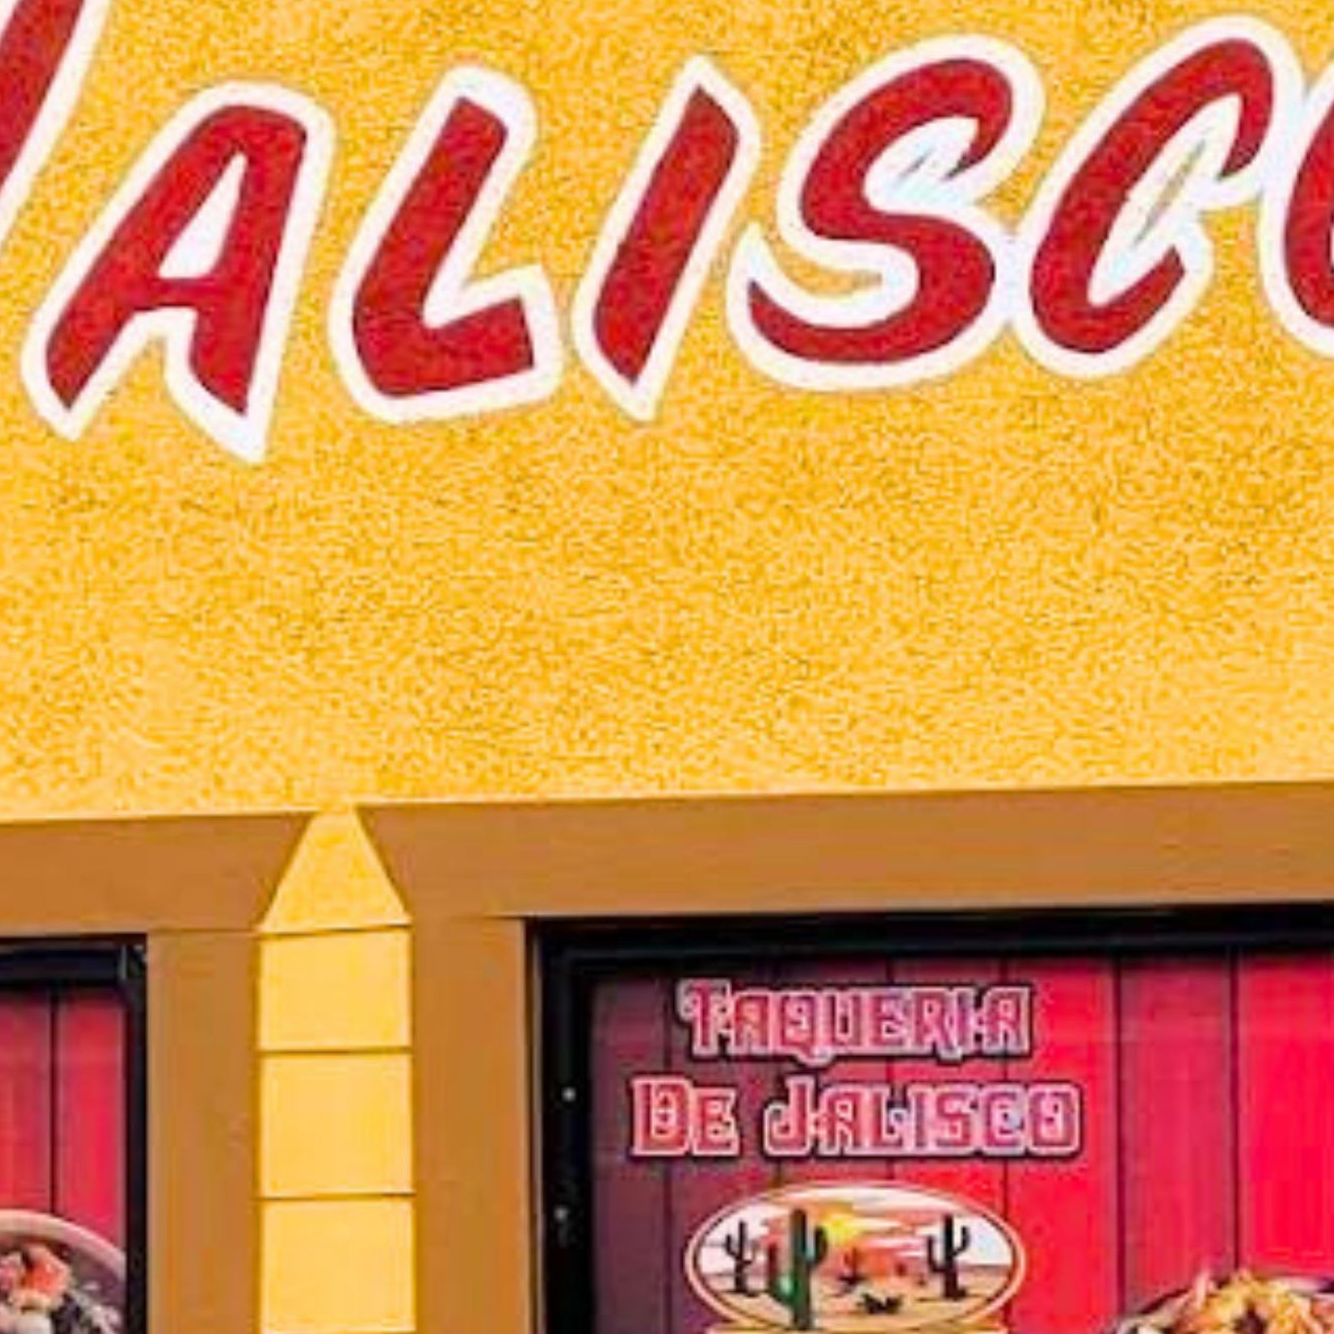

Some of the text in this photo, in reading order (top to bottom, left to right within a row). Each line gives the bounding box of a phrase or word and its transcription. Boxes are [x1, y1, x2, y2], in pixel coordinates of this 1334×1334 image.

[677, 978, 1031, 1064] TAQUERIA
[632, 1075, 1081, 1157] DE JALISCO
